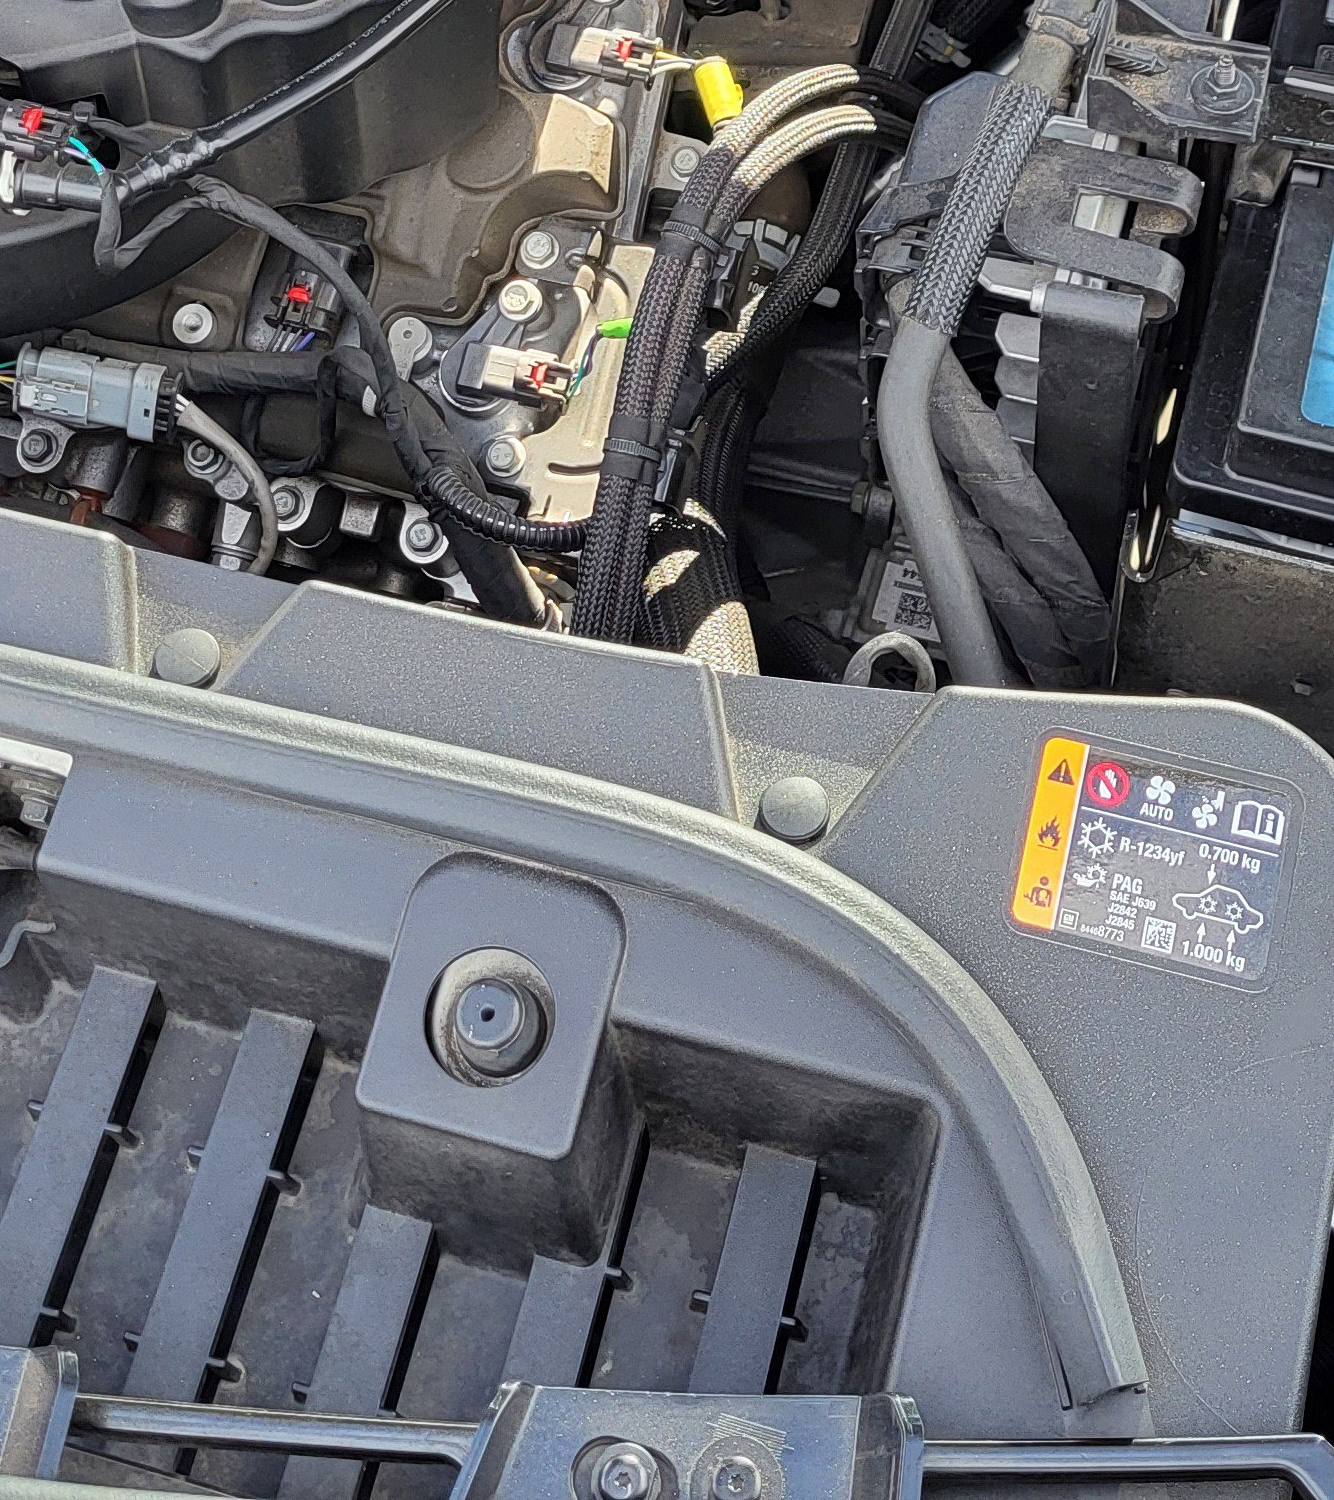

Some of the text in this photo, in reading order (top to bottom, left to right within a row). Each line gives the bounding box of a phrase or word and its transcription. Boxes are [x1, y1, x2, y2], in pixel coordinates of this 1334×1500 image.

[1139, 802, 1174, 822] AUTO
[1119, 839, 1185, 867] R-1234yf
[1199, 843, 1261, 874] 0.700 kg
[1113, 873, 1143, 894] PAG
[1107, 901, 1138, 919] J2842
[1110, 890, 1157, 911] SAE J639
[1105, 913, 1136, 930] J2845
[1182, 940, 1246, 971] 1.000 kg
